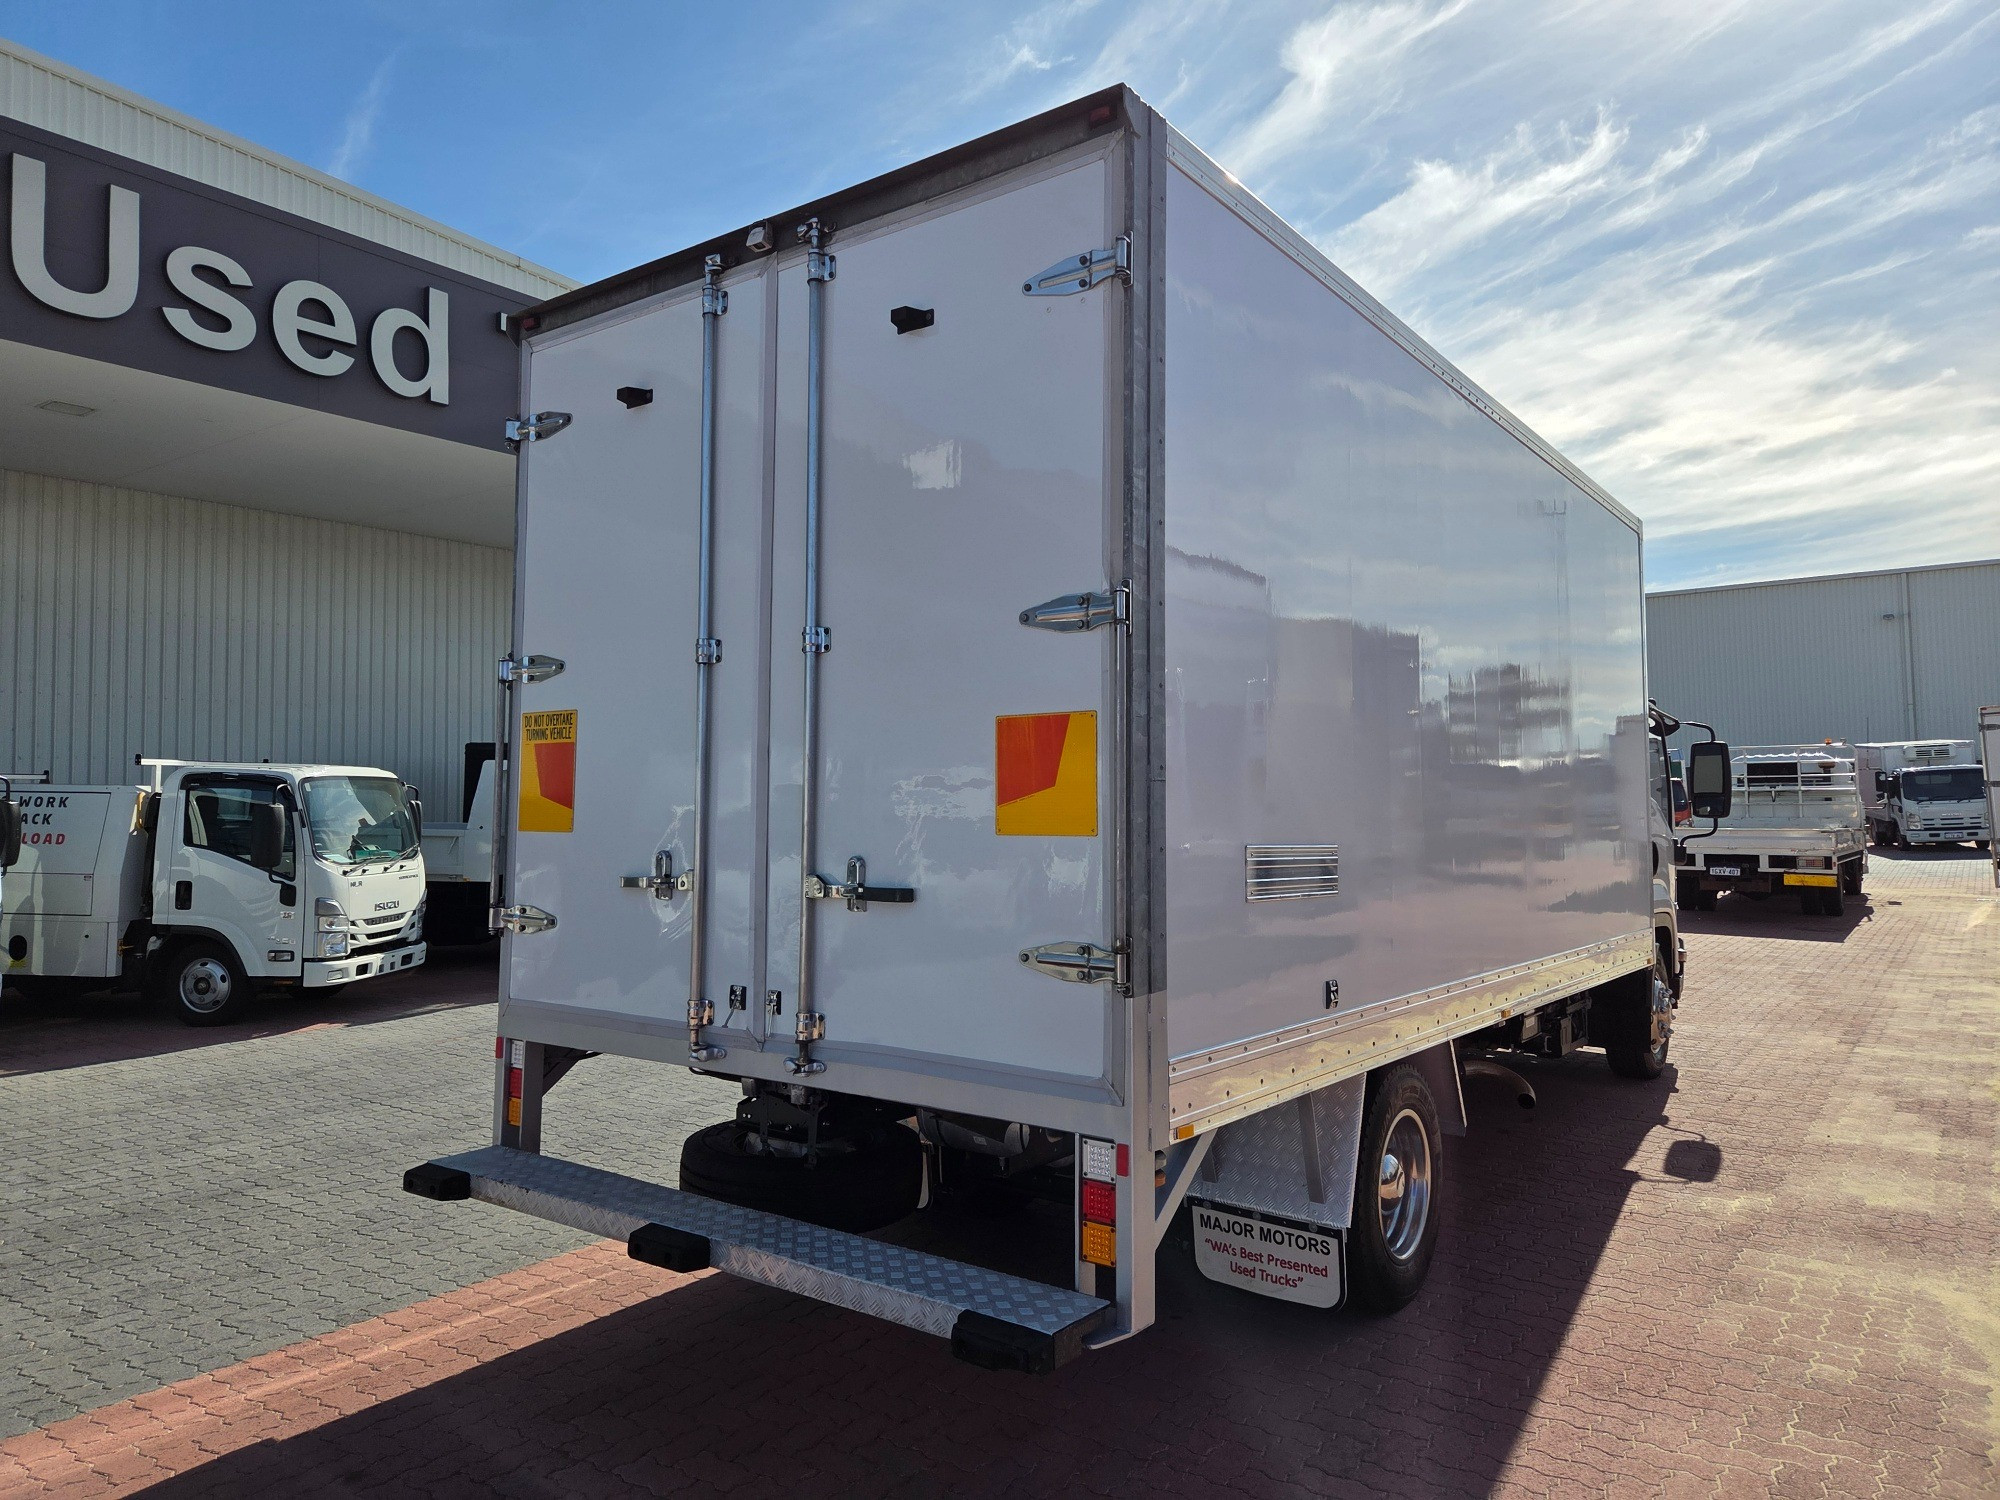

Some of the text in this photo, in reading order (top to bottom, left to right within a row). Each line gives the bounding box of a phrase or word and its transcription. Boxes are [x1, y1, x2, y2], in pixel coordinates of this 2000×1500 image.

[11, 152, 450, 406] Used
[525, 712, 573, 728] DO NOT OVERTAKE
[526, 726, 572, 741] TURNING VEHICLE
[20, 795, 69, 808] WORK
[20, 812, 52, 825] ACK
[374, 900, 400, 911] ISUZU
[1200, 1213, 1331, 1256] MAJOR MOTORS
[1230, 1260, 1256, 1279] Used
[1240, 1246, 1264, 1264] Best
[1267, 1253, 1328, 1278] Presented
